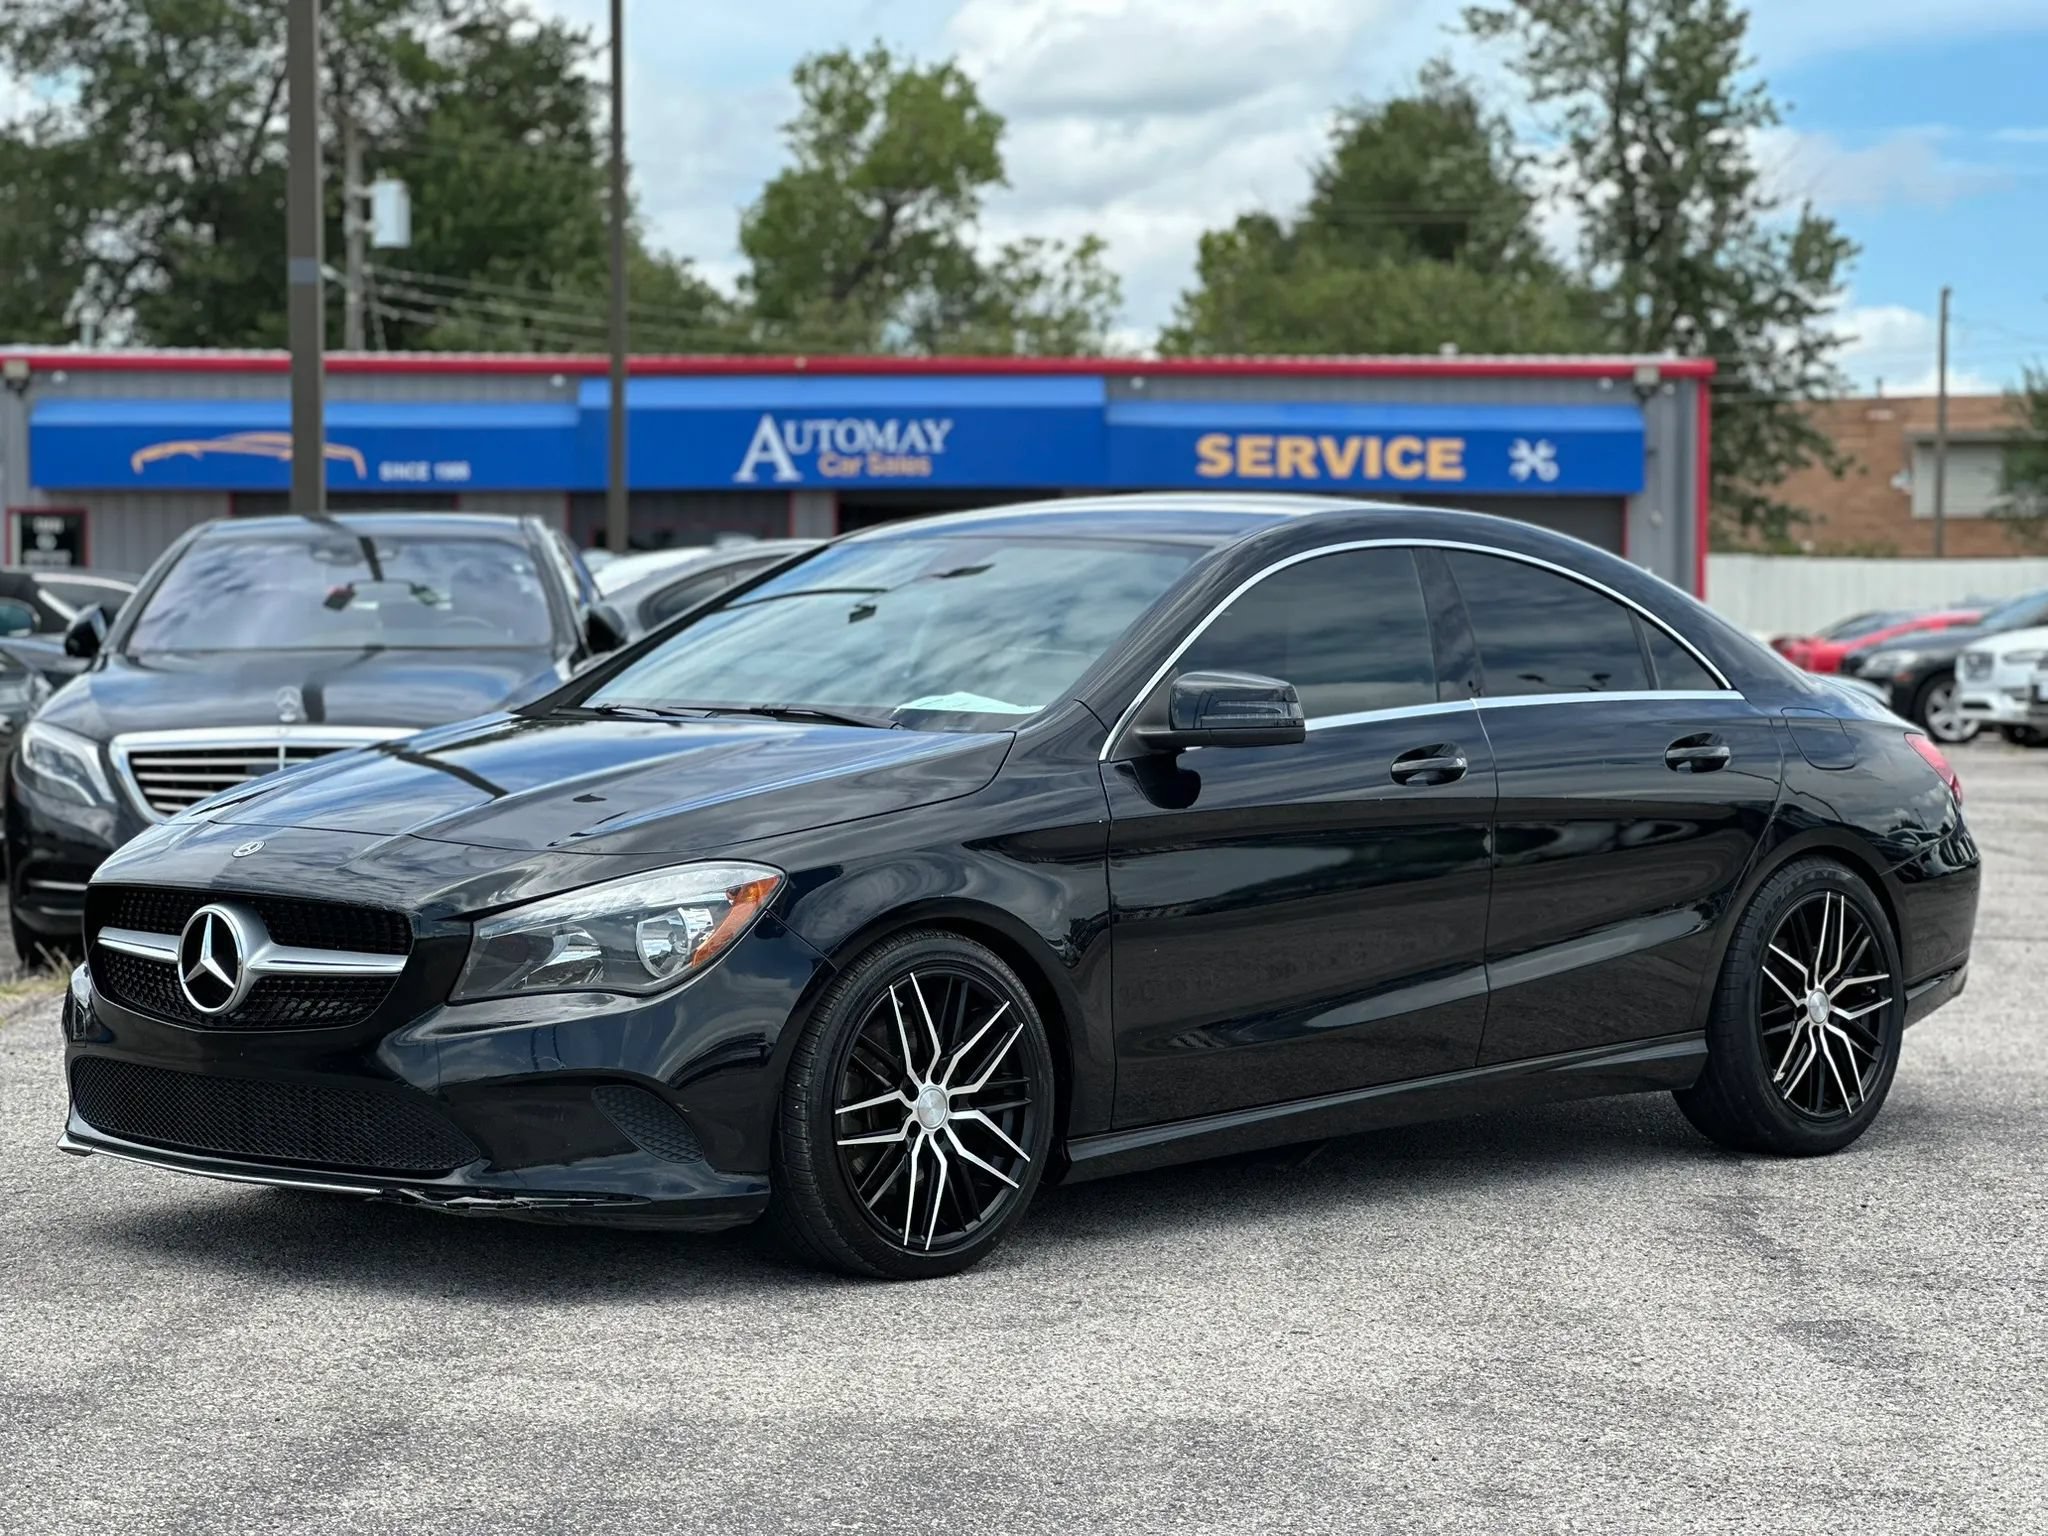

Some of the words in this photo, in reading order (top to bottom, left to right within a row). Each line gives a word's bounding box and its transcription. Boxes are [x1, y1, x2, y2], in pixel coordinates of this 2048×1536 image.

[734, 413, 954, 482] AUTOMAY
[818, 452, 863, 477] Car
[1196, 434, 1466, 481] SERVICE
